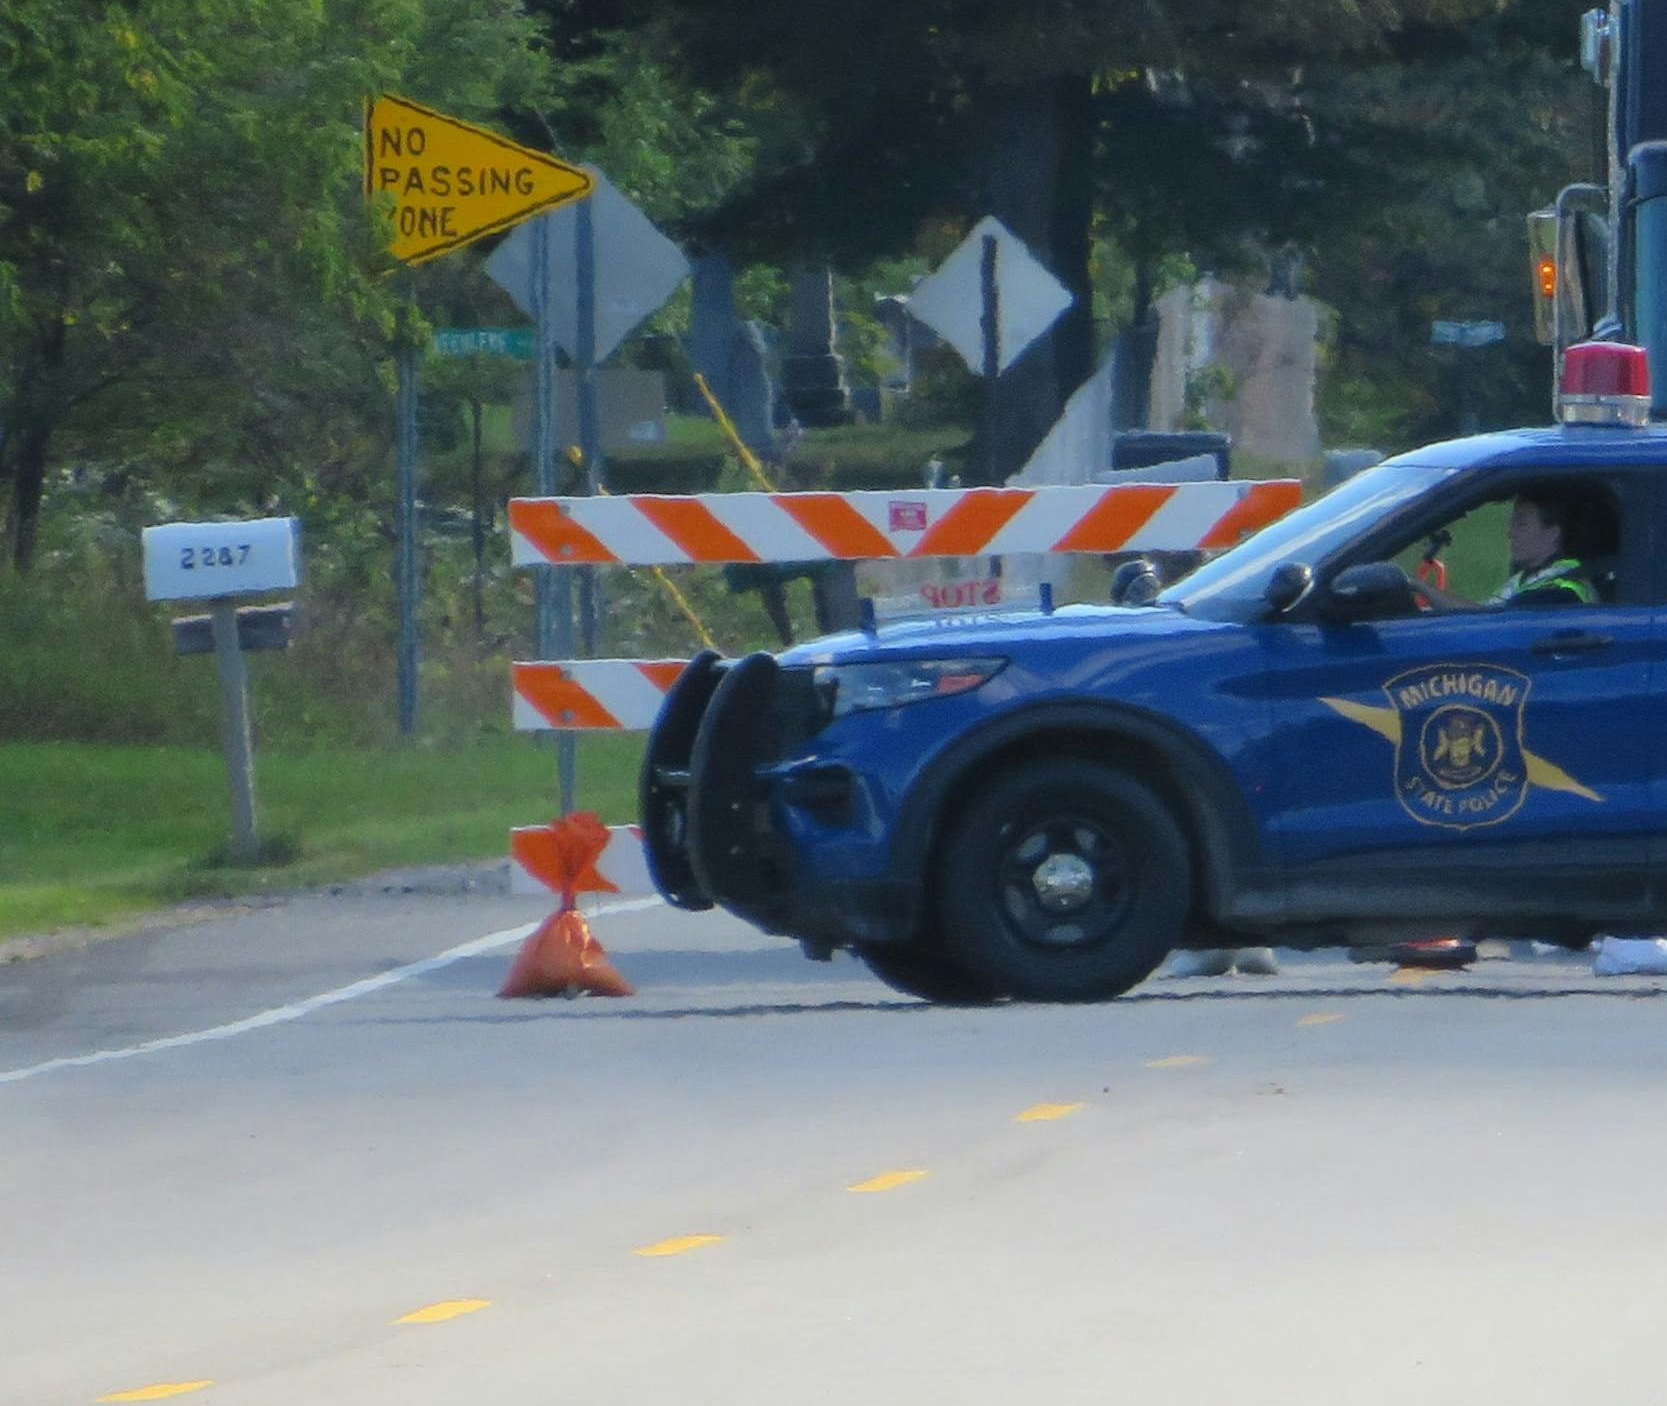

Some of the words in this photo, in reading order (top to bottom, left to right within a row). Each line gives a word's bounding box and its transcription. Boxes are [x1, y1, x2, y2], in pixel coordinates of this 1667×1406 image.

[380, 126, 426, 158] NO
[379, 165, 535, 196] PASSING
[180, 545, 251, 570] 2287
[1400, 673, 1519, 710] MICHIGAN
[1404, 776, 1453, 814] STATE
[1458, 769, 1518, 813] POLICE
